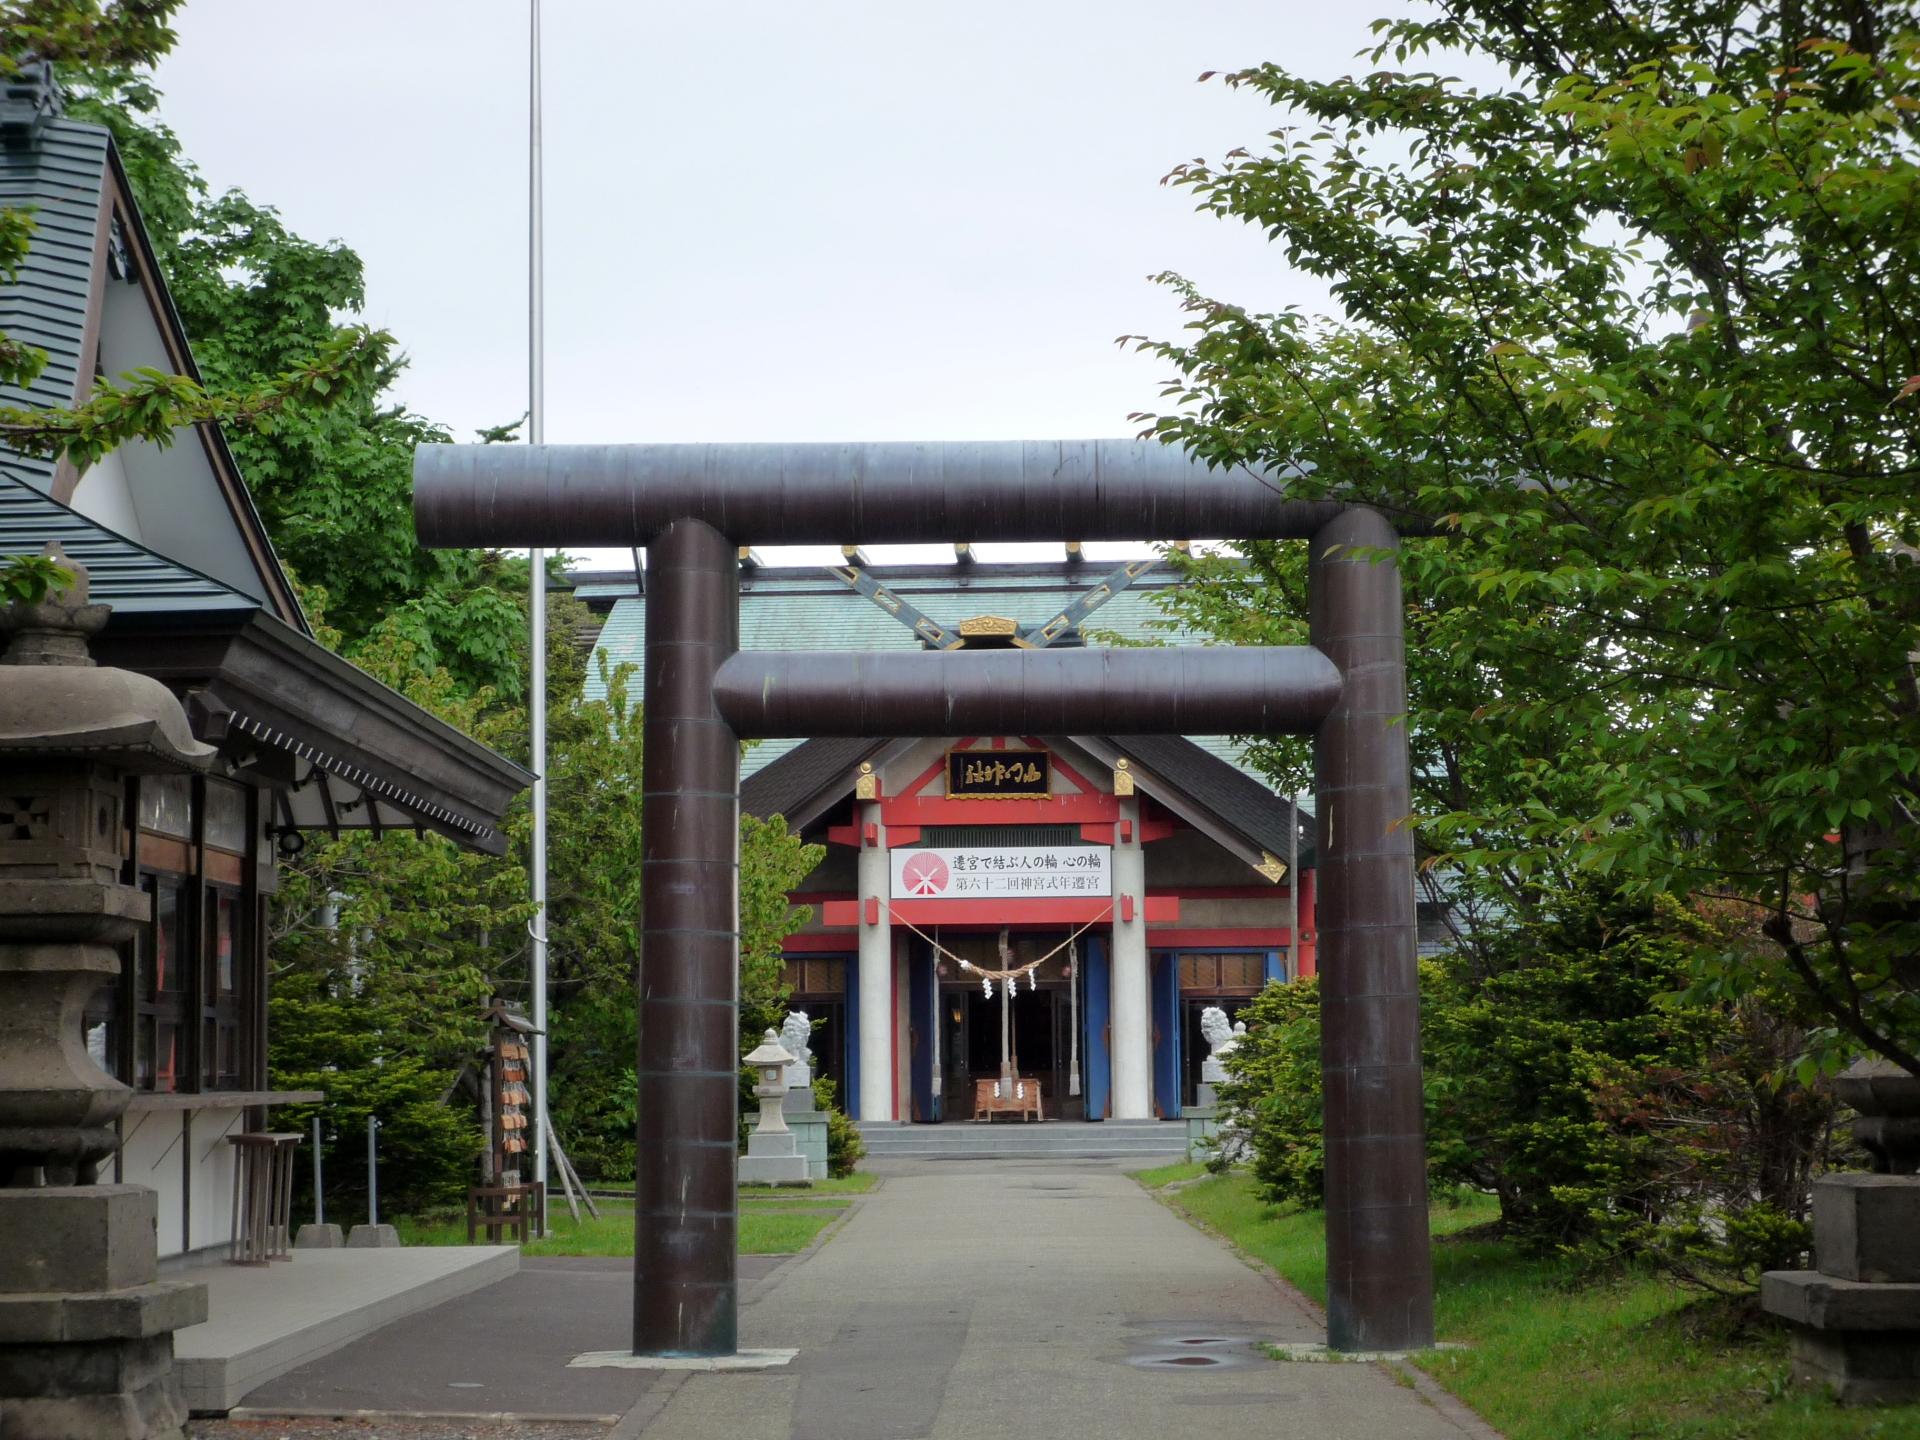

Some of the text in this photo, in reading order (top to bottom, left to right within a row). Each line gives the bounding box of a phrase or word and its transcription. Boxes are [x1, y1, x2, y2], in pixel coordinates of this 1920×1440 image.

[1062, 853, 1101, 869] 心の輪
[955, 875, 1100, 891] 第六十二回神宮式年遷宮
